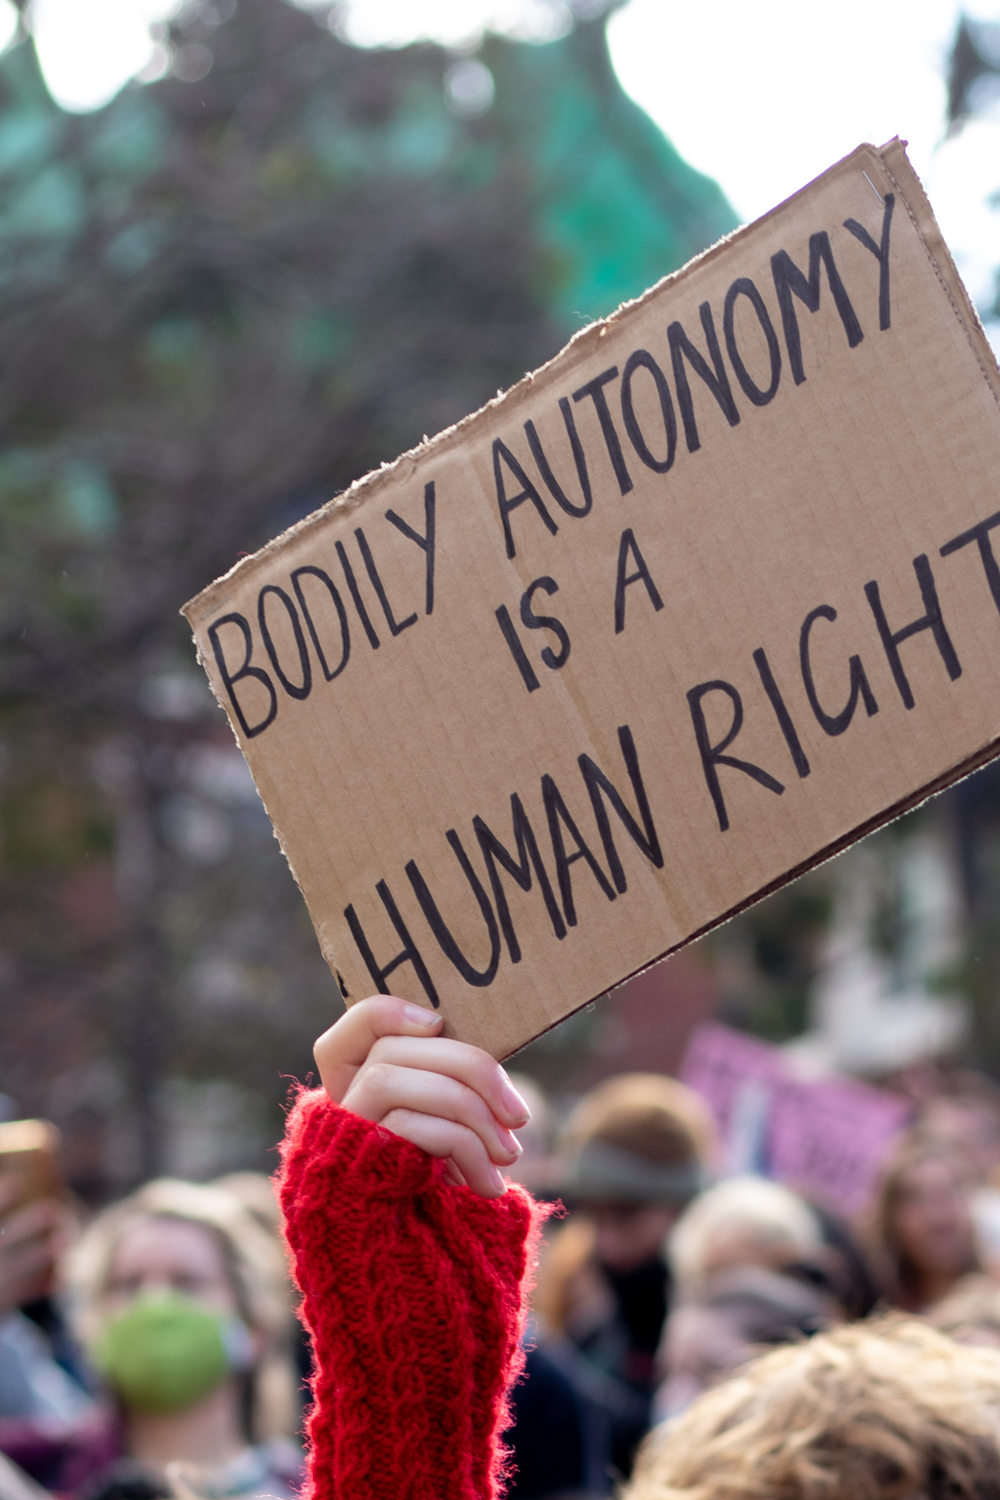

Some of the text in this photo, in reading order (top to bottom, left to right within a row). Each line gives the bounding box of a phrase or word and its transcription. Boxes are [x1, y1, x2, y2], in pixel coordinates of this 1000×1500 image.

[207, 192, 896, 739] BODILY AUTONOMY
[495, 527, 665, 693] IS A
[343, 725, 664, 1009] HUMAN
